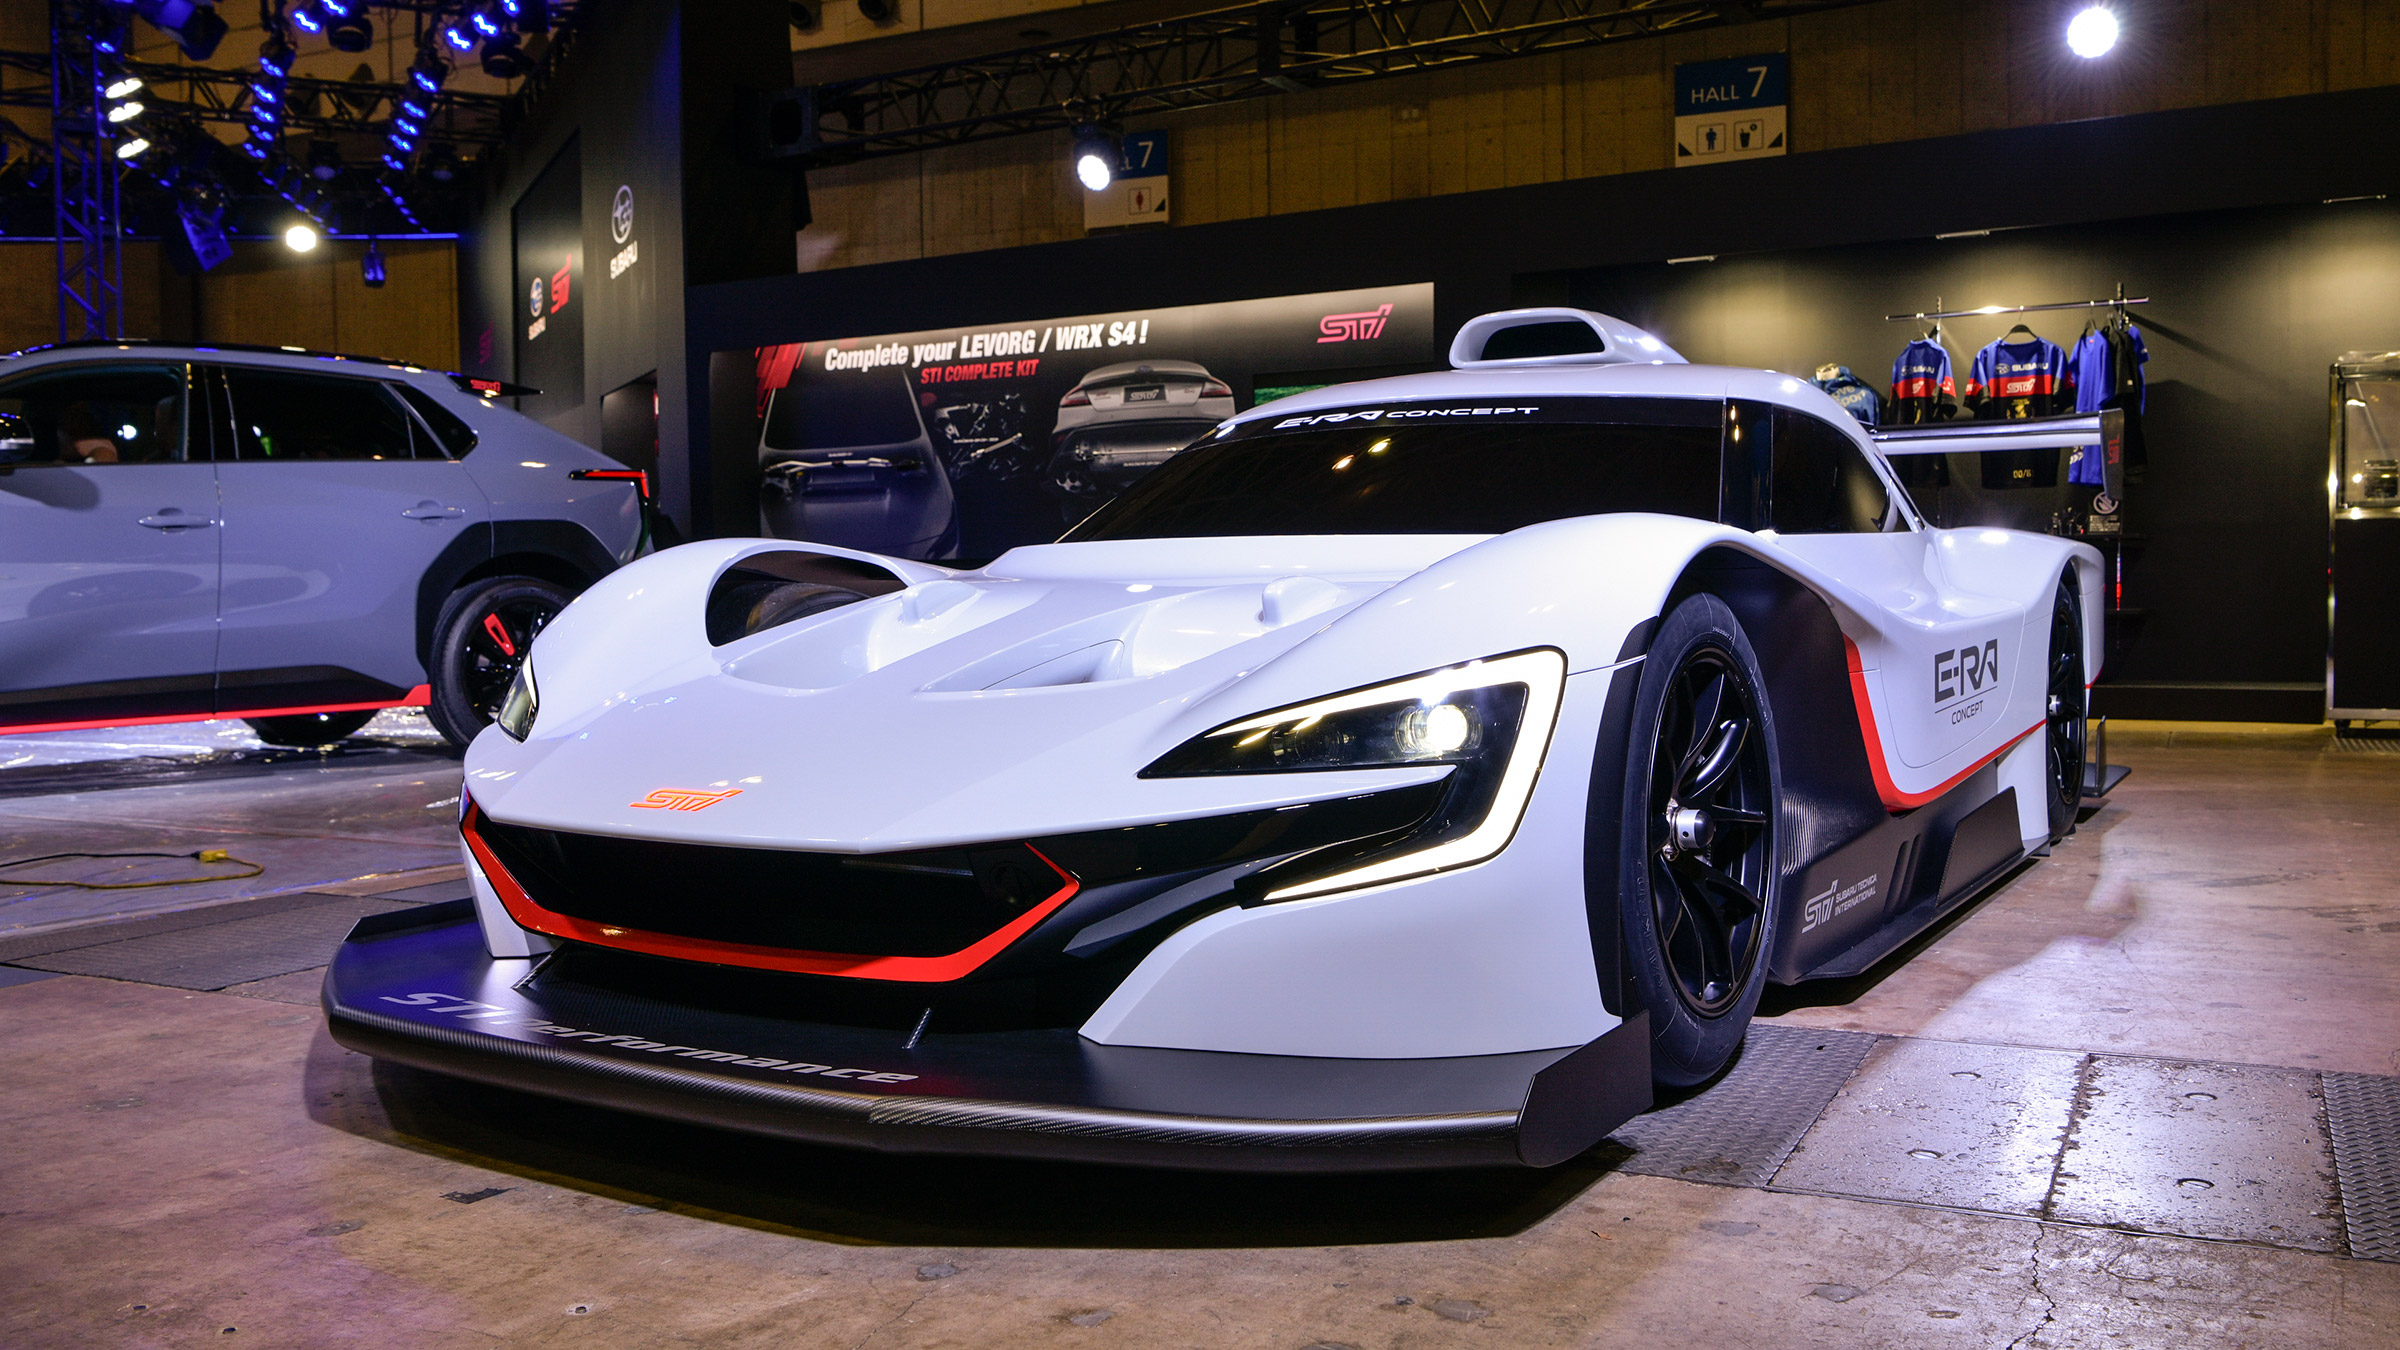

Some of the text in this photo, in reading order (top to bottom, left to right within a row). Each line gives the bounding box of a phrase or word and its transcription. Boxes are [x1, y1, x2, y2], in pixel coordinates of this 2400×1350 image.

[1691, 66, 1768, 104] HALL 7
[1138, 141, 1154, 169] 7
[824, 343, 909, 373] Complete
[911, 341, 957, 368] your
[959, 329, 1037, 360] LEVORG
[1038, 327, 1052, 353] /
[1055, 323, 1105, 351] WRX
[920, 358, 1040, 384] STI COMPLETE KIT
[1273, 407, 1539, 429] E-RA CONCEPT
[1934, 638, 1998, 703] E-RA
[1951, 699, 1983, 725] CONCEPT
[1834, 885, 1877, 917] INTERNATIONAL
[1836, 873, 1878, 904] SUBARU TECNICA
